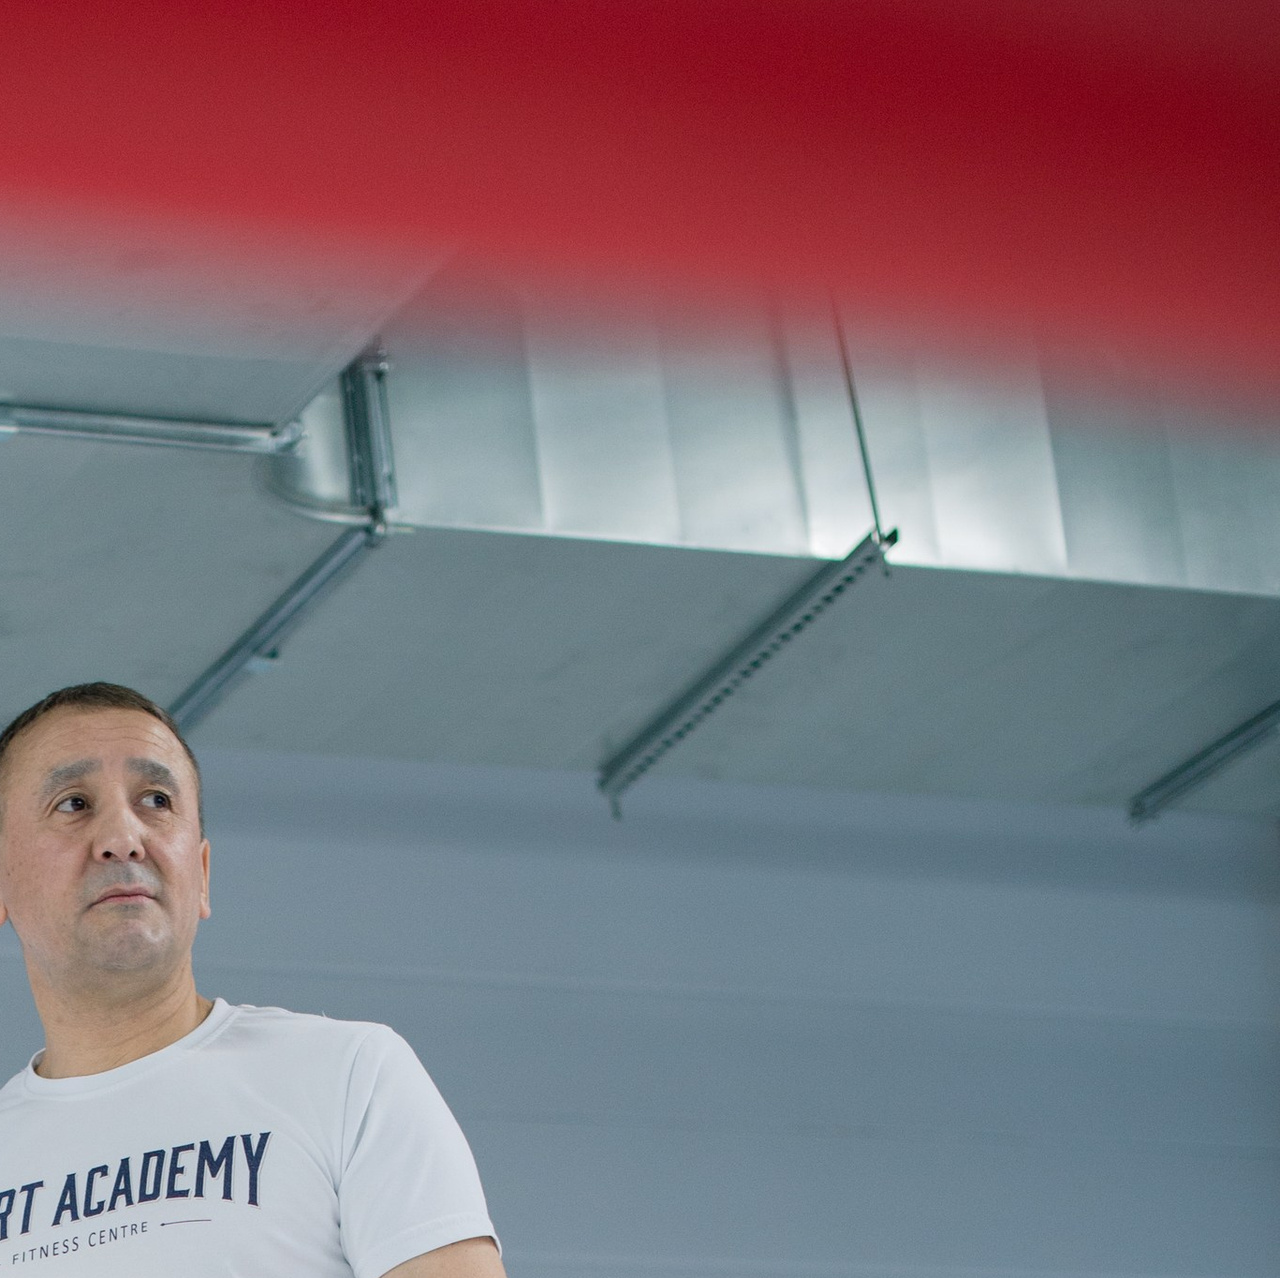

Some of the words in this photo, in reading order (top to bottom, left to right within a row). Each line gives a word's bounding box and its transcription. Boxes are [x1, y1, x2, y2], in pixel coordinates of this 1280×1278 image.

[51, 1131, 272, 1227] ACADEMY
[12, 1237, 80, 1265] FITNESS
[88, 1221, 150, 1248] CENTRE
